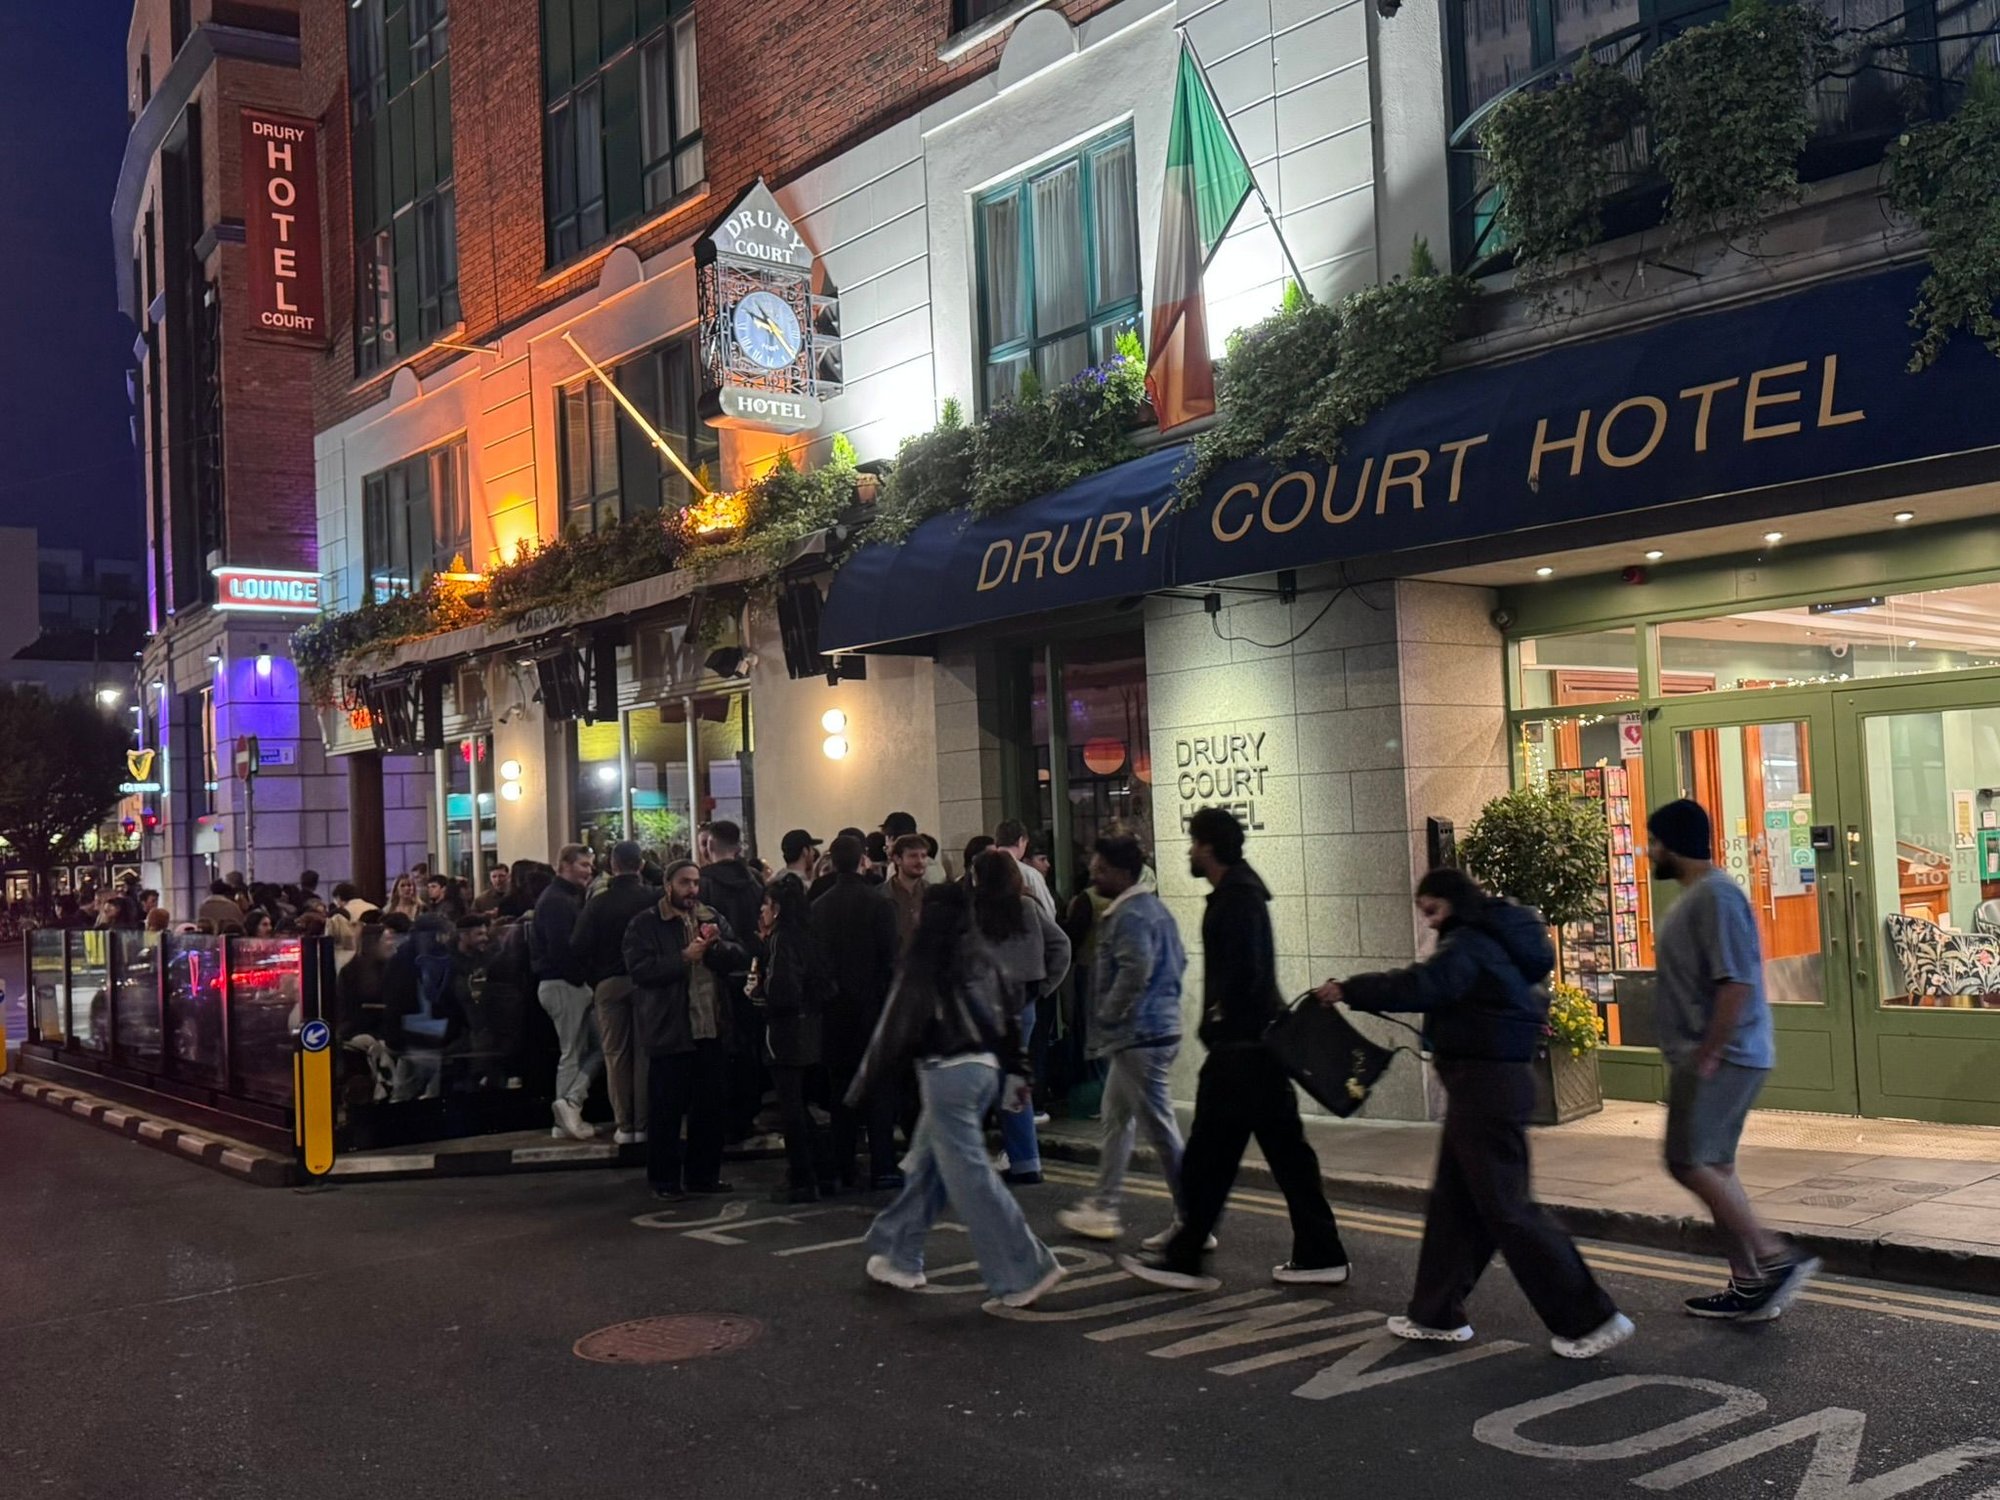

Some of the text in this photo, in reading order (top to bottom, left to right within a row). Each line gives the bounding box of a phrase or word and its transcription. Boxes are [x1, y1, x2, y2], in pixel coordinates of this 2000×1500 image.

[252, 121, 305, 142] DRURY
[267, 141, 298, 312] HOTEL
[725, 209, 805, 251] DRURY
[735, 239, 794, 265] COURT
[261, 311, 315, 331] COURT
[737, 396, 806, 420] HOTEL
[976, 353, 1866, 592] DRURY COURT HOTEL
[229, 577, 318, 602] LOUNGE
[1175, 731, 1266, 768] DRURY
[1177, 765, 1269, 800] COURT
[1179, 800, 1265, 834] HEL
[1914, 870, 1979, 885] HOTEL
[1466, 1374, 2000, 1500] ON
